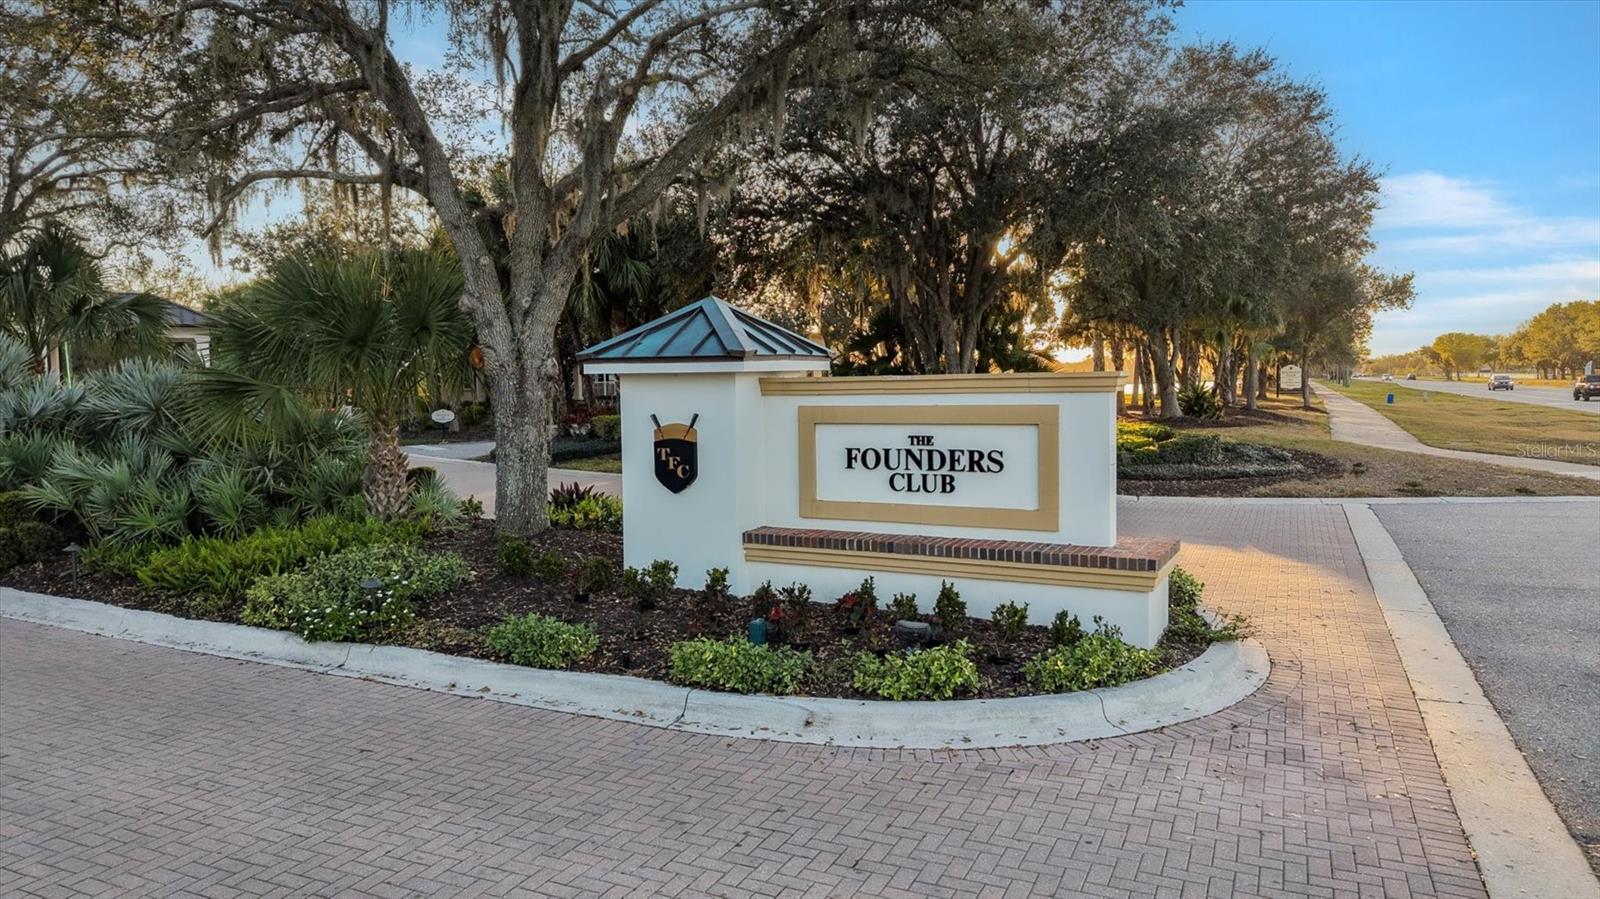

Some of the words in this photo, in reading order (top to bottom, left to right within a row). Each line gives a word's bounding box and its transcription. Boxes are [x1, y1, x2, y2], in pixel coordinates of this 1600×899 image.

[908, 435, 934, 446] THE
[657, 447, 690, 478] TFC
[845, 448, 1005, 474] FOUNDERS
[889, 472, 956, 494] CLUB
